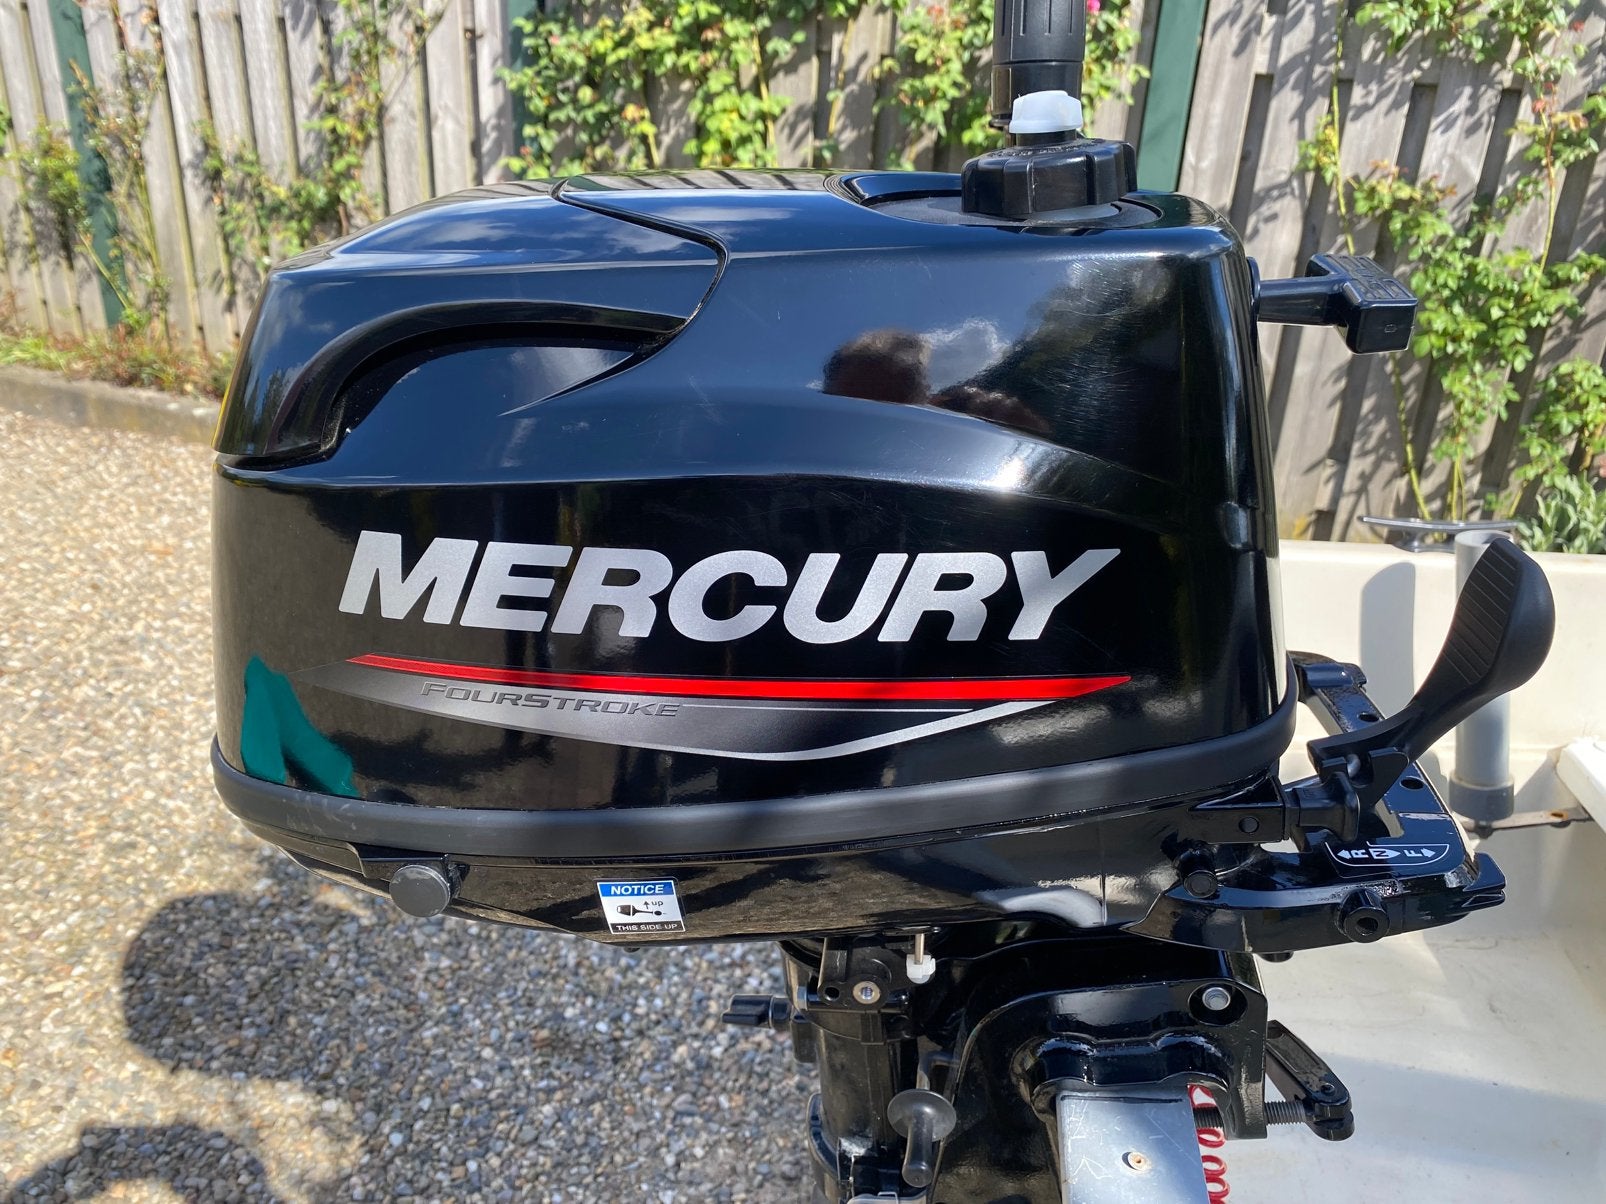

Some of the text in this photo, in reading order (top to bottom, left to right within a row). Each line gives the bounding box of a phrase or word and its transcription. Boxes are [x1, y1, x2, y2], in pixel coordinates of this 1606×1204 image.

[338, 530, 1121, 645] MERCURY
[1350, 849, 1369, 859] R
[1403, 849, 1423, 858] F
[610, 884, 664, 895] NOTICE
